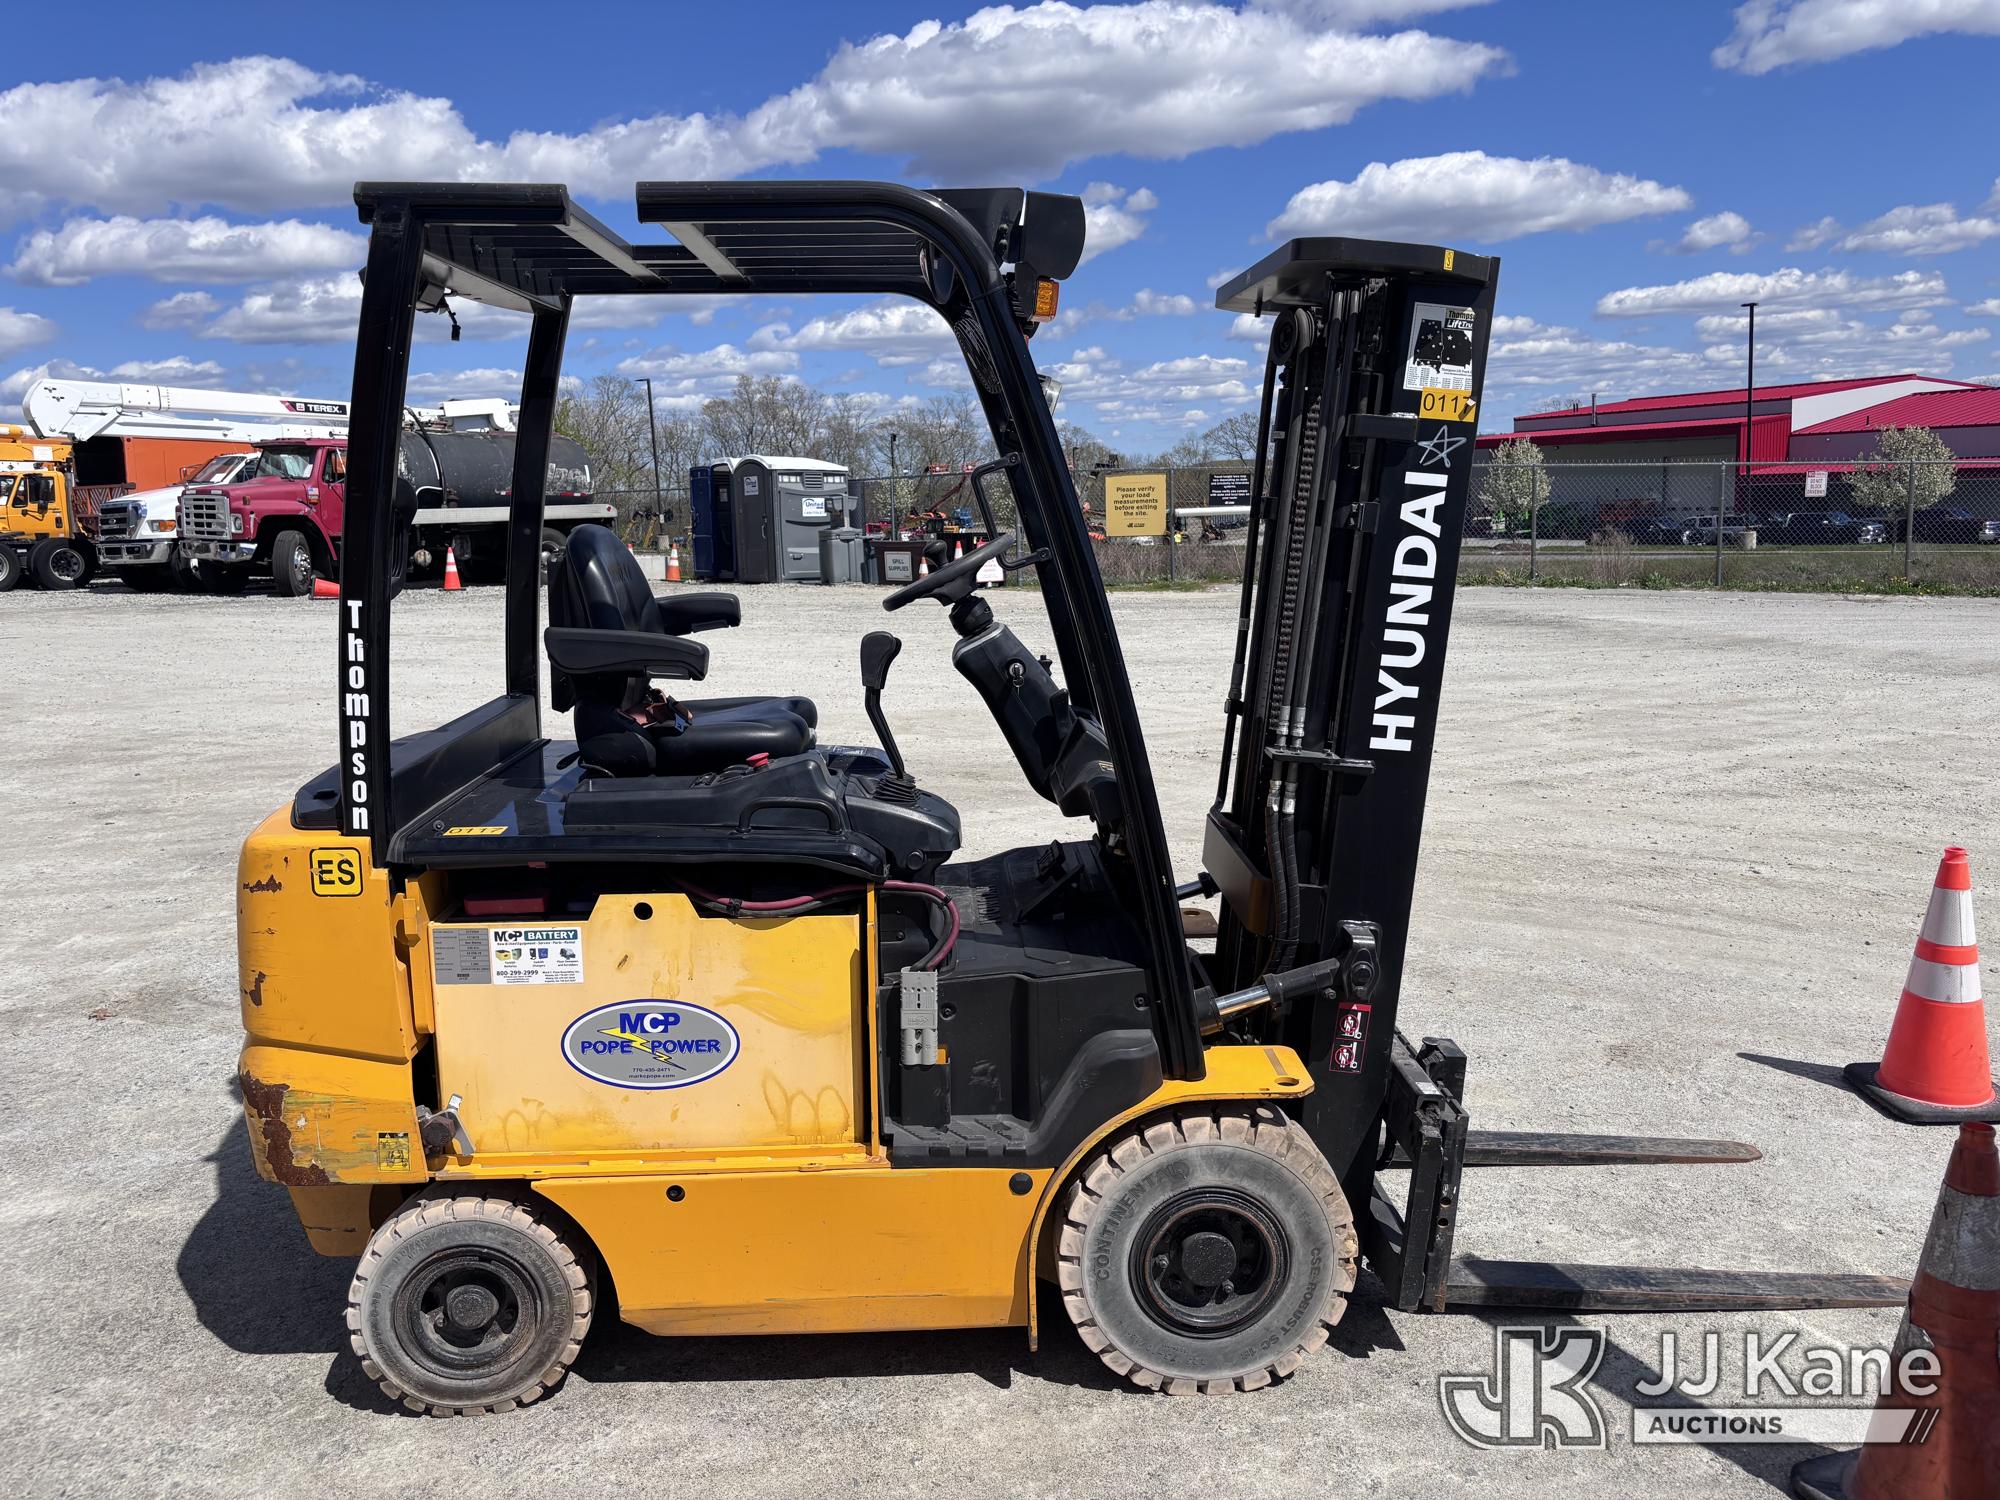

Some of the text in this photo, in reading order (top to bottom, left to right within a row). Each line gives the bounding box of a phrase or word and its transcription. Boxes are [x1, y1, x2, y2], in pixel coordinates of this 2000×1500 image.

[307, 404, 340, 413] TEREX
[1369, 471, 1449, 752] HYUNDAI
[345, 600, 370, 830] Thompson
[448, 827, 504, 835] 0117
[317, 859, 355, 885] ES
[494, 930, 575, 942] MCP BATTERY
[619, 1012, 681, 1034] MCP
[580, 1039, 722, 1055] POPE POWER
